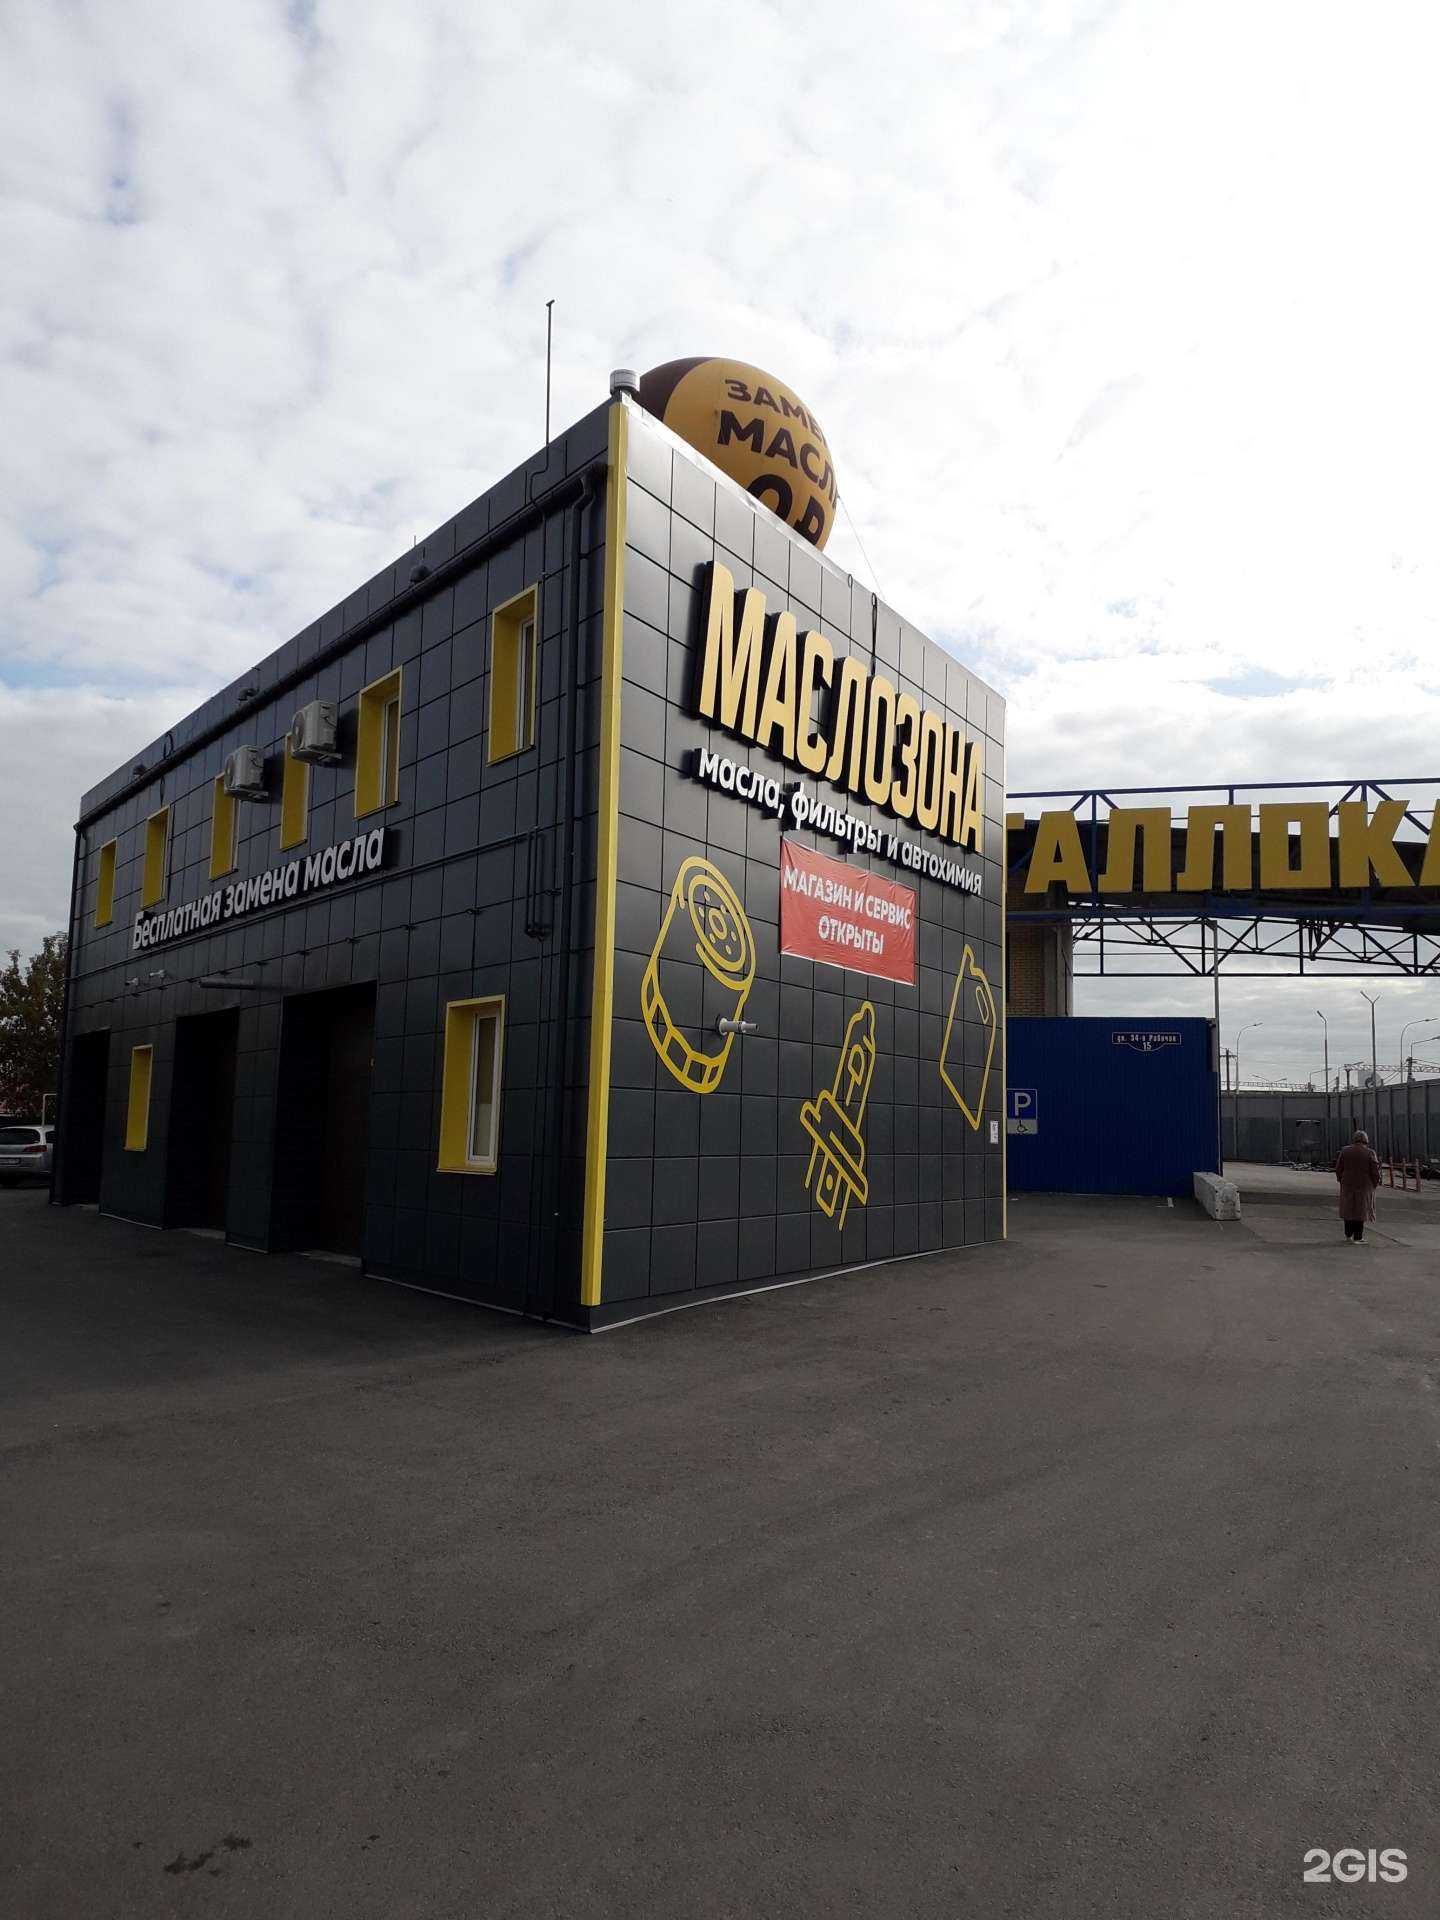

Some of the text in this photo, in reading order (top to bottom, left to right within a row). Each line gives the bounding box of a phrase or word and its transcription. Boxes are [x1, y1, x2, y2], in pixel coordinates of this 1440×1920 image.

[725, 379, 828, 446] ЗАМЕ
[717, 410, 838, 511] МАСЛ
[700, 560, 983, 853] МАСЛОЗОНА
[699, 748, 983, 895] масла, фильтры и автохимия
[1005, 799, 1440, 893] АЛЛОК
[132, 827, 385, 950] Бесплатная замена масла
[783, 866, 912, 929] МАГАЗИН И СЕРВИС
[818, 915, 884, 955] ОТКРЫТЫ
[1142, 1042, 1152, 1050] 15
